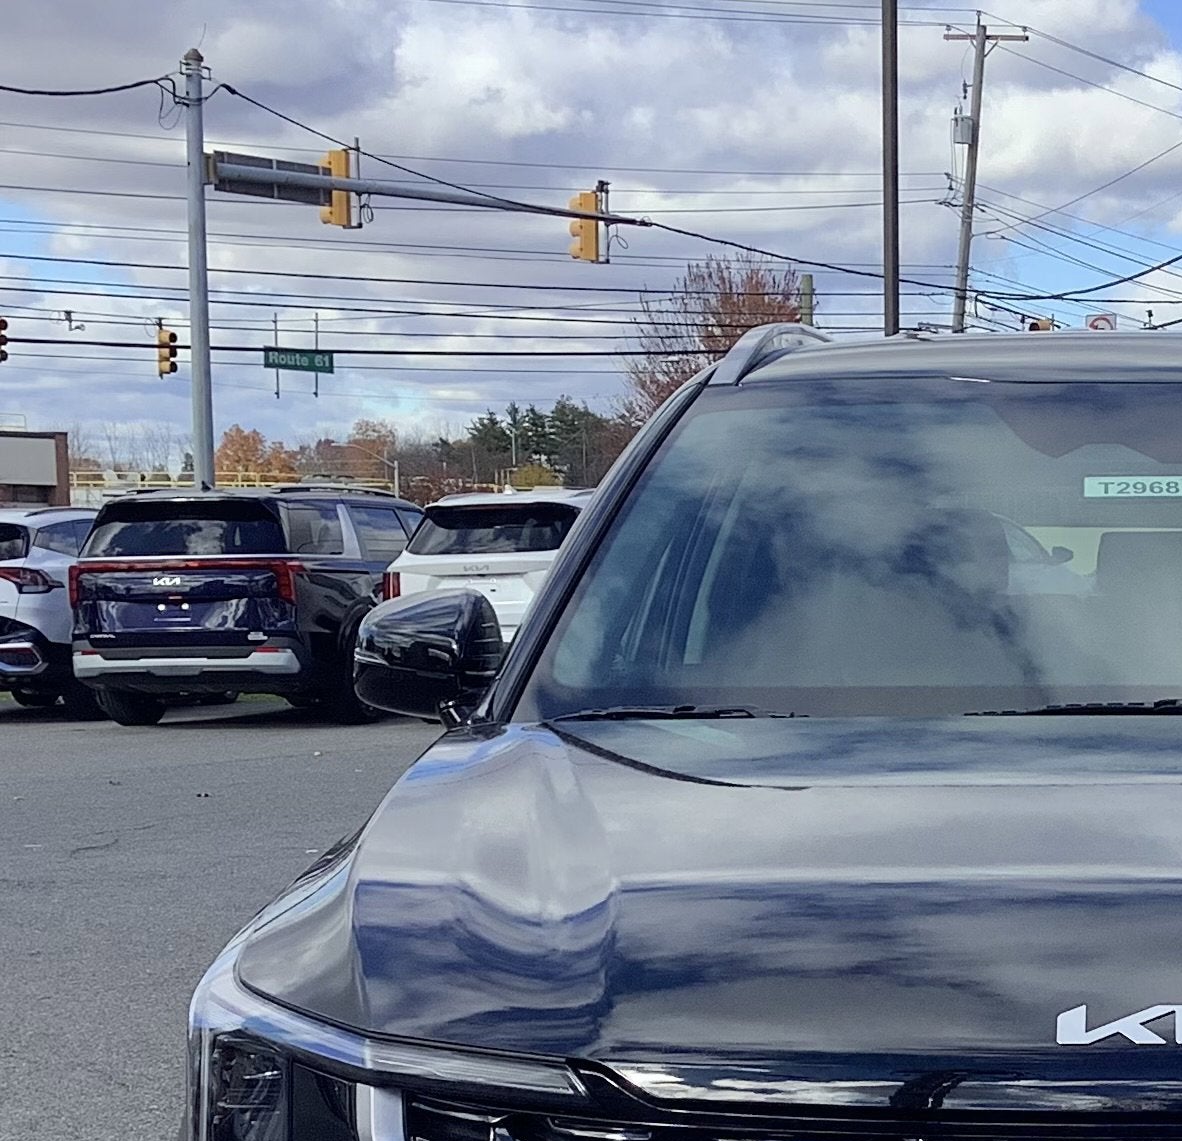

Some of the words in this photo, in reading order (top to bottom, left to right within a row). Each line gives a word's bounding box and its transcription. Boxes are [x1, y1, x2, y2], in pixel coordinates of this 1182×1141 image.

[269, 351, 309, 366] Route
[315, 355, 329, 367] 61
[1098, 481, 1180, 494] T2968
